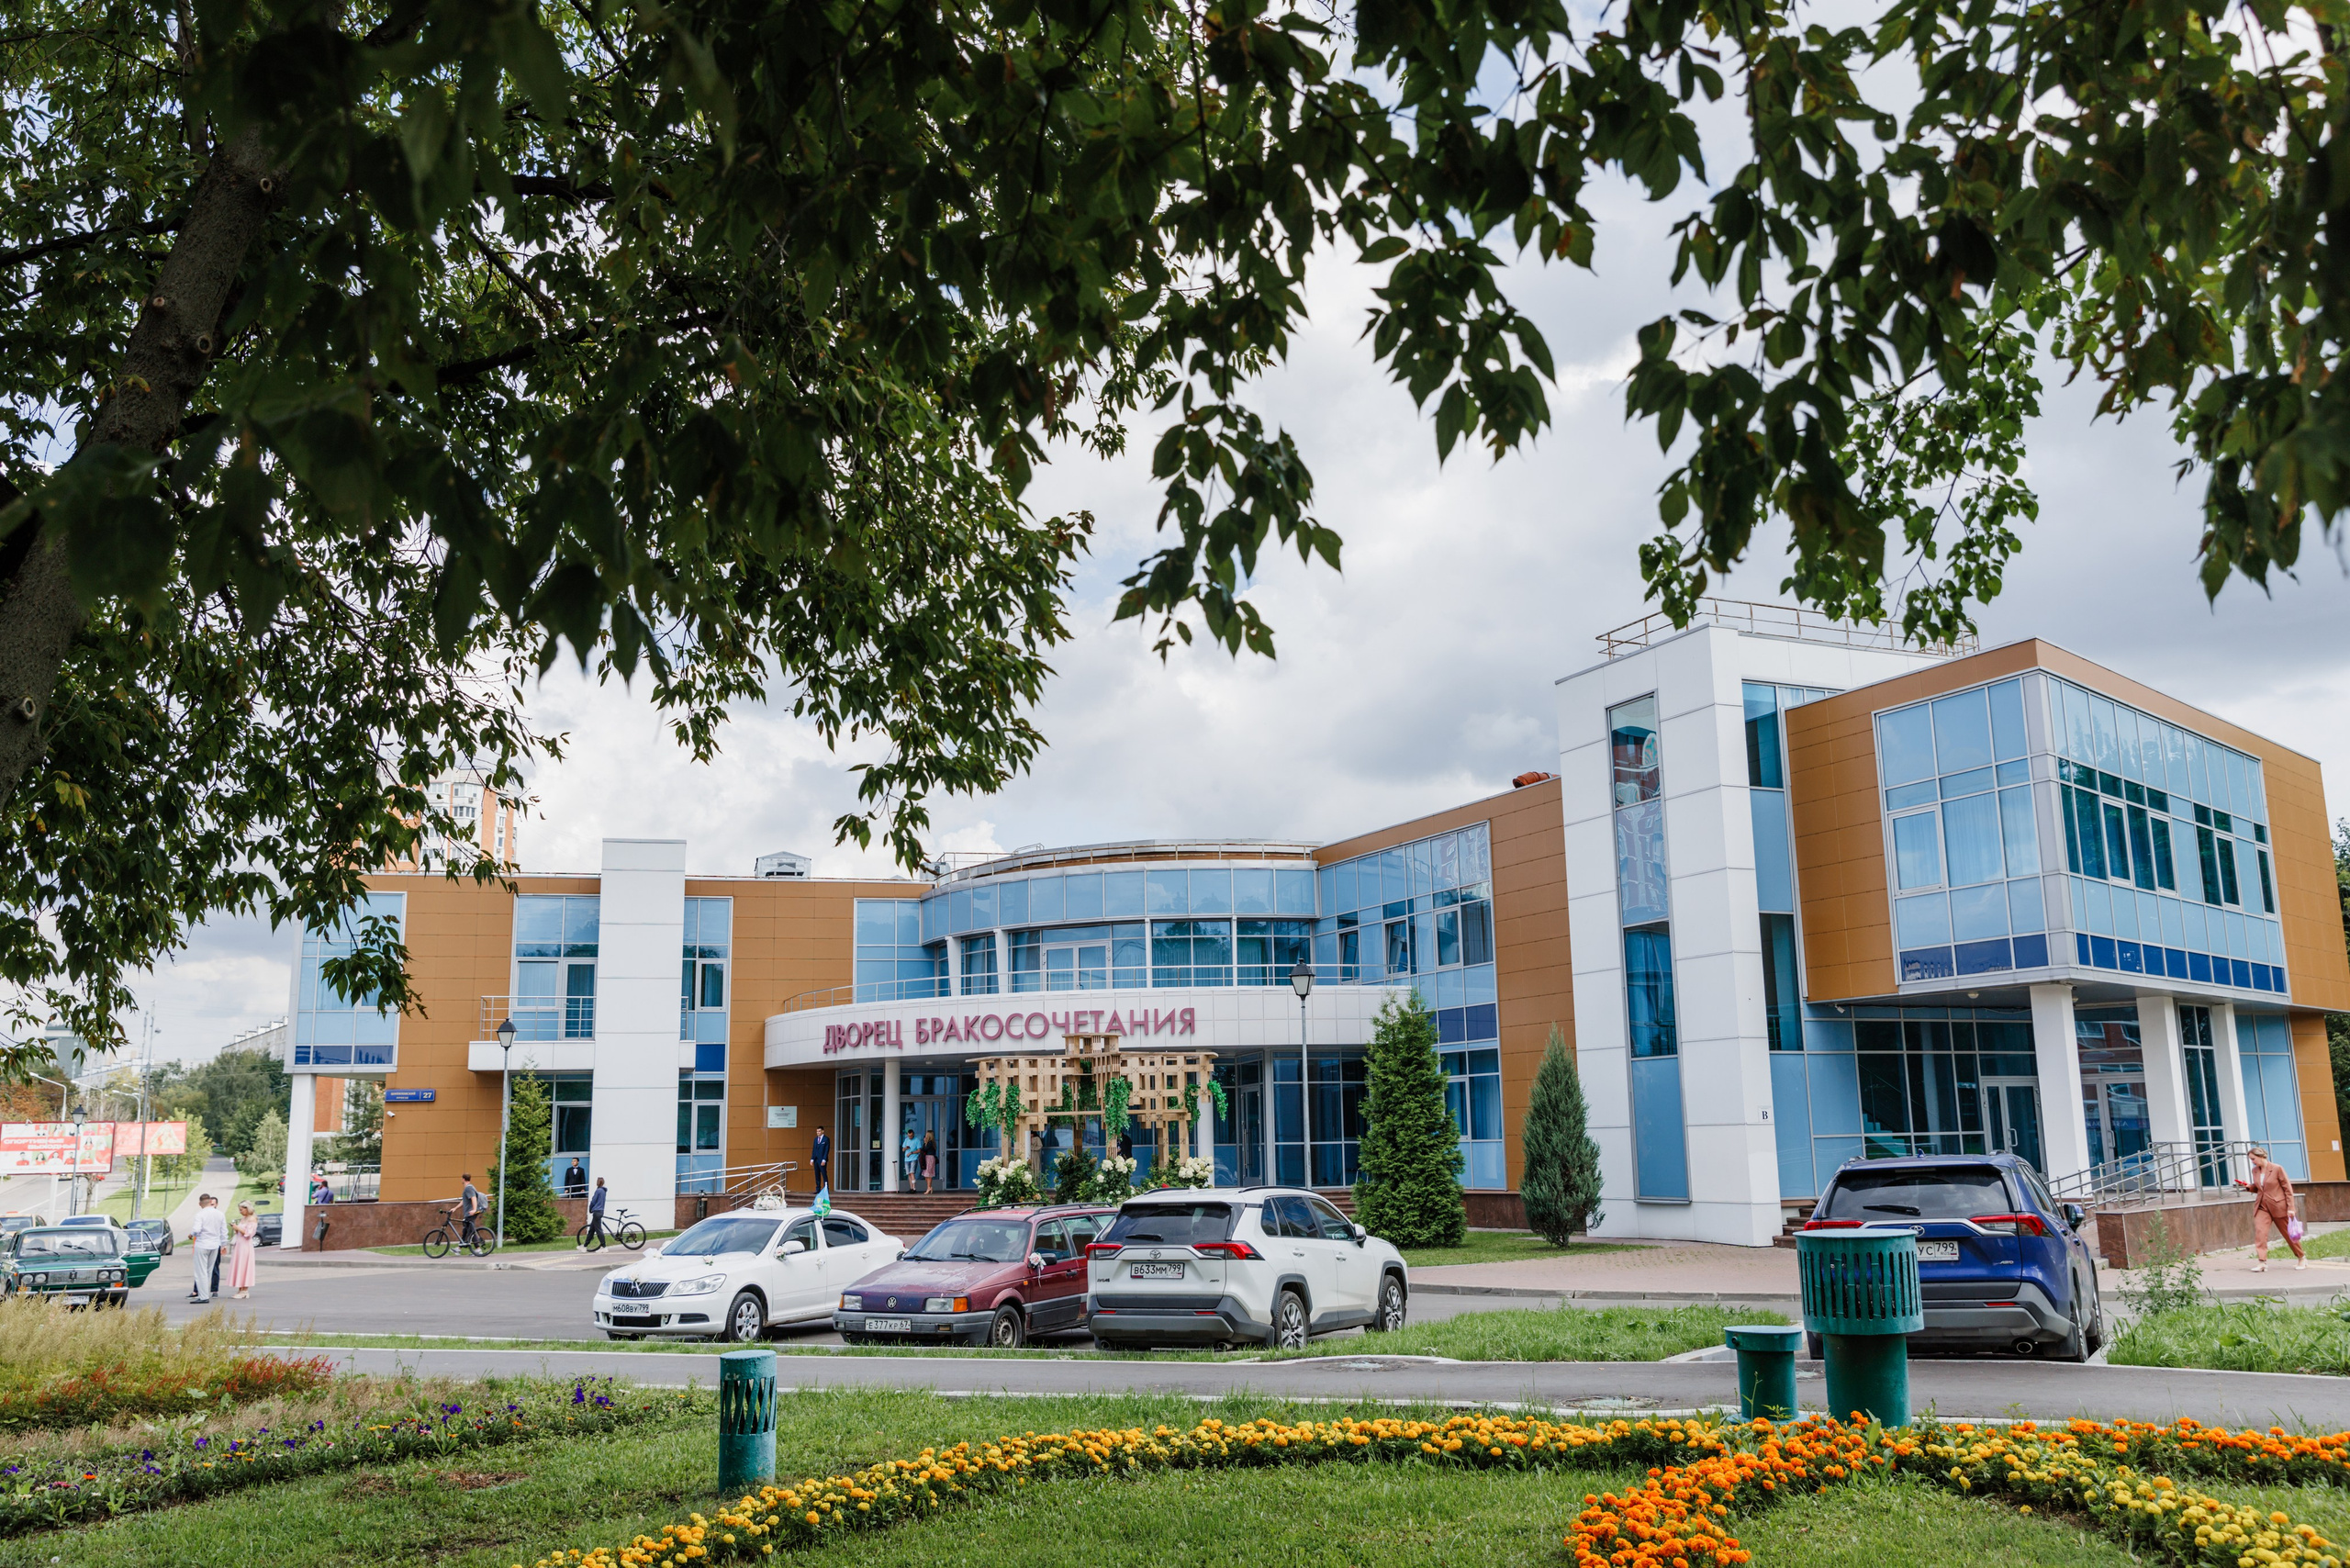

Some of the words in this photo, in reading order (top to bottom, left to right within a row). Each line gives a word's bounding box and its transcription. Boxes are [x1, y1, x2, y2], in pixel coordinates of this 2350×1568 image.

[823, 1019, 903, 1054] ДВОРЕЦ
[916, 1007, 1195, 1045] БРАКОСОЧЕТАНИЯ
[1935, 1242, 1955, 1252] 799
[1134, 1264, 1168, 1275] В633ММ
[1168, 1263, 1181, 1272] 799
[613, 1304, 638, 1313] М608ВУ
[868, 1320, 899, 1330] Е377КР
[900, 1320, 908, 1328] 67
